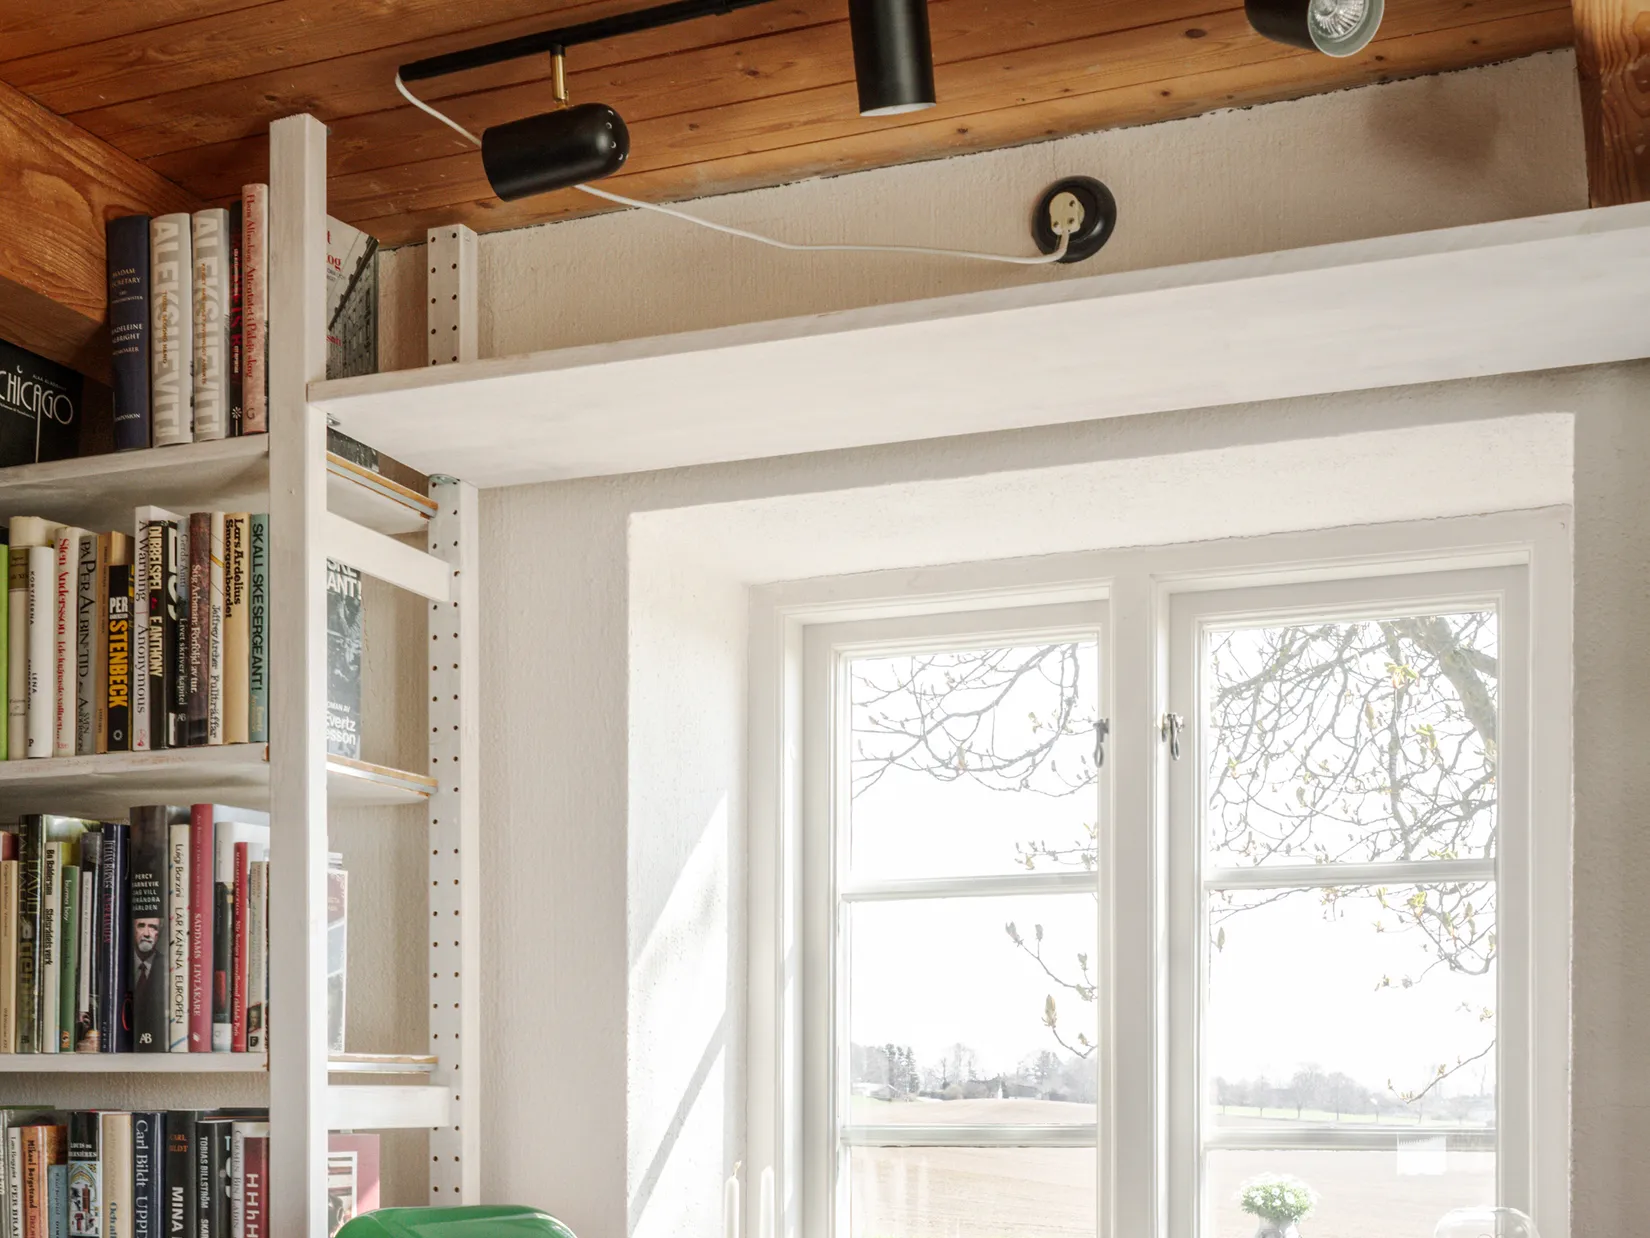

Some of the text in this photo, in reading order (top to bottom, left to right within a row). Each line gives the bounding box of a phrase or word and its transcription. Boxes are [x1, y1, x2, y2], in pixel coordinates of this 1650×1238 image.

[234, 518, 244, 605] Lars Ardelius
[252, 523, 264, 573] SKALL
[57, 537, 69, 636] Sten Andersson
[191, 564, 201, 581] Stig
[252, 573, 264, 605] SKE
[79, 559, 97, 678] PER TID
[110, 597, 128, 613] PER
[136, 520, 150, 714] A Warning Anonymous
[177, 533, 189, 705] Gerda Antti Livet skriver kapitel
[108, 620, 128, 708] STENBECK
[190, 627, 202, 664] Förföljd
[252, 606, 263, 691] SERGEANT!
[191, 665, 199, 677] av
[210, 604, 222, 738] Jeffrey Archer Fullträffar
[171, 843, 183, 866] Luigi
[45, 861, 55, 896] Balderson
[173, 866, 184, 898] Barzini
[63, 879, 72, 922] burma boy
[174, 907, 184, 928] LÄR
[45, 908, 55, 949] Statsrådets
[193, 913, 203, 959] SADDAMS
[45, 950, 54, 966] verk
[174, 929, 186, 970] KÄNNA
[28, 1139, 37, 1166] Mikael
[136, 1119, 149, 1150] Carl
[200, 1136, 209, 1165] TOBIAS
[233, 1130, 243, 1173] CARMEN
[27, 1167, 38, 1209] Bergstrand
[136, 1153, 150, 1188] Bildt
[200, 1165, 211, 1209] BILLSTRÖM
[233, 1176, 242, 1195] BIN
[171, 1186, 184, 1233] MINA
[233, 1197, 242, 1229] LADIN
